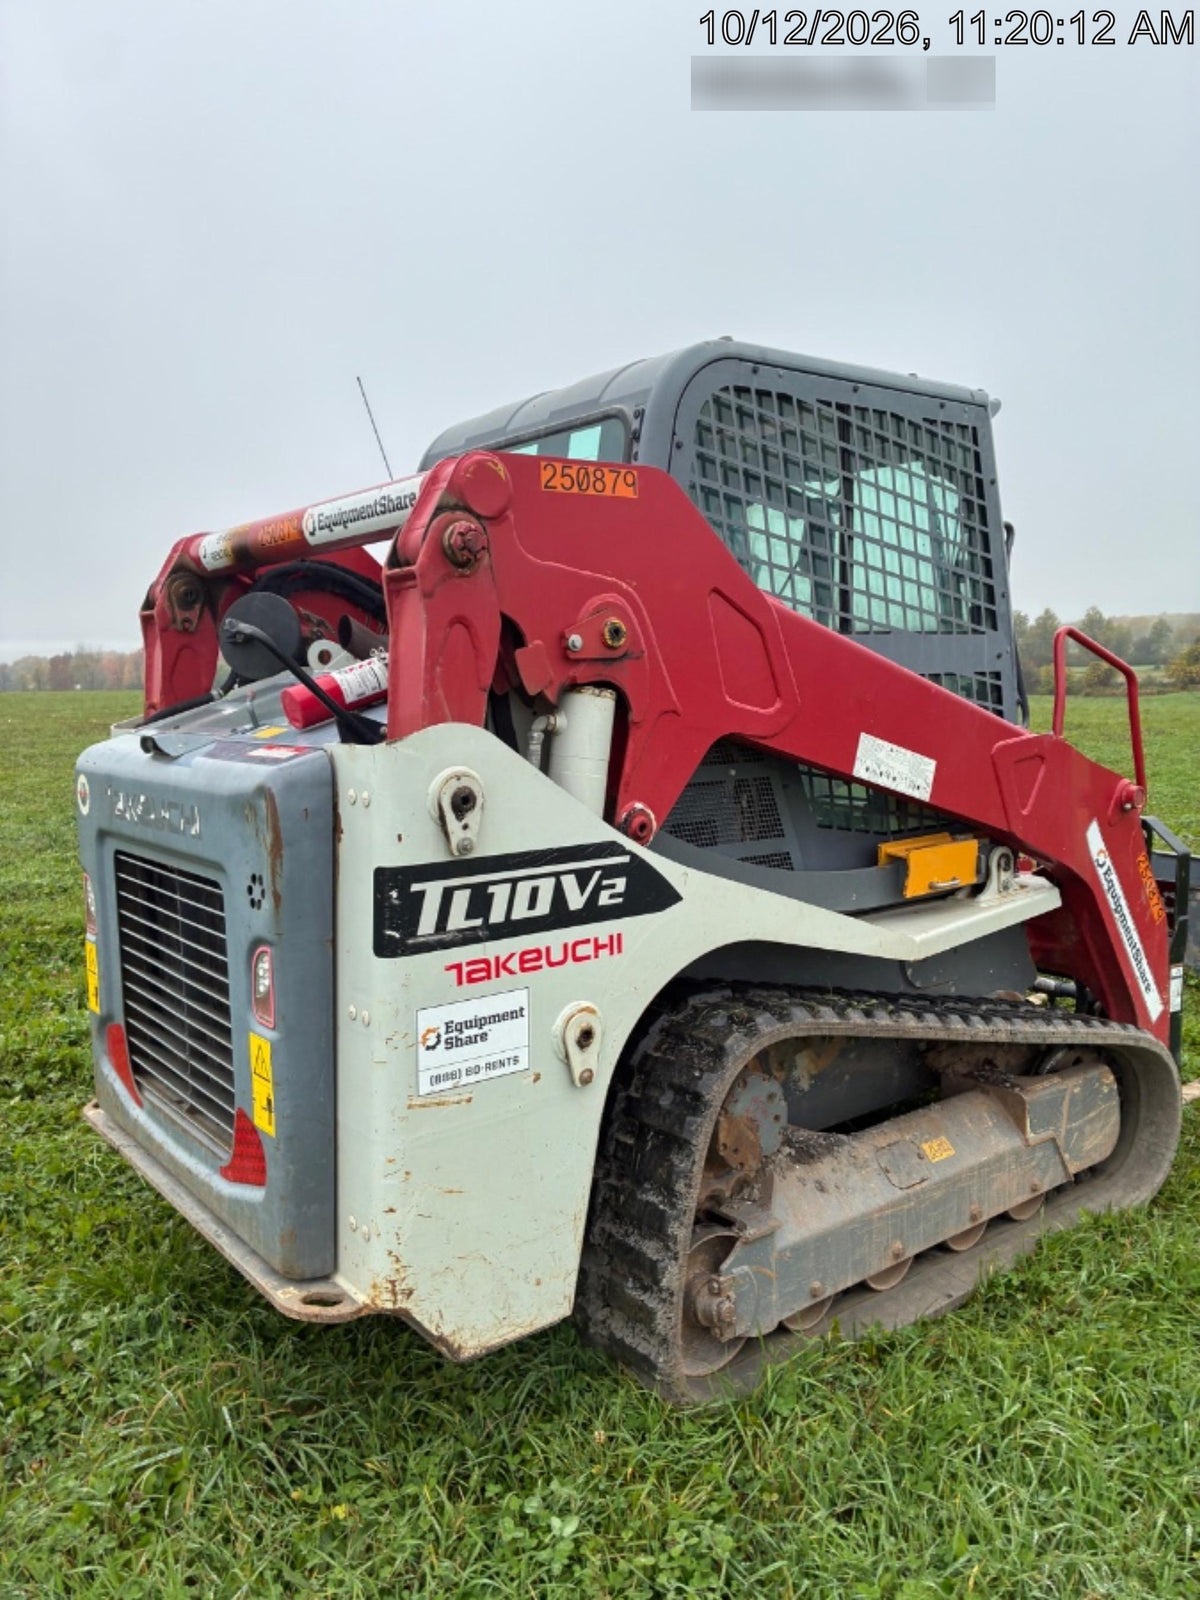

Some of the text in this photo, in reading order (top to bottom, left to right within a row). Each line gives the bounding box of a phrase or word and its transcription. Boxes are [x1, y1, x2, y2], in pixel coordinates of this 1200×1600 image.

[543, 463, 637, 495] 250879
[317, 491, 417, 532] EquipmentShare
[410, 855, 631, 936] TL10V2
[1102, 866, 1152, 994] EquipmentShare
[444, 933, 623, 986] TAKEUCHI
[444, 1006, 525, 1035] Equipment
[444, 1031, 488, 1050] Share
